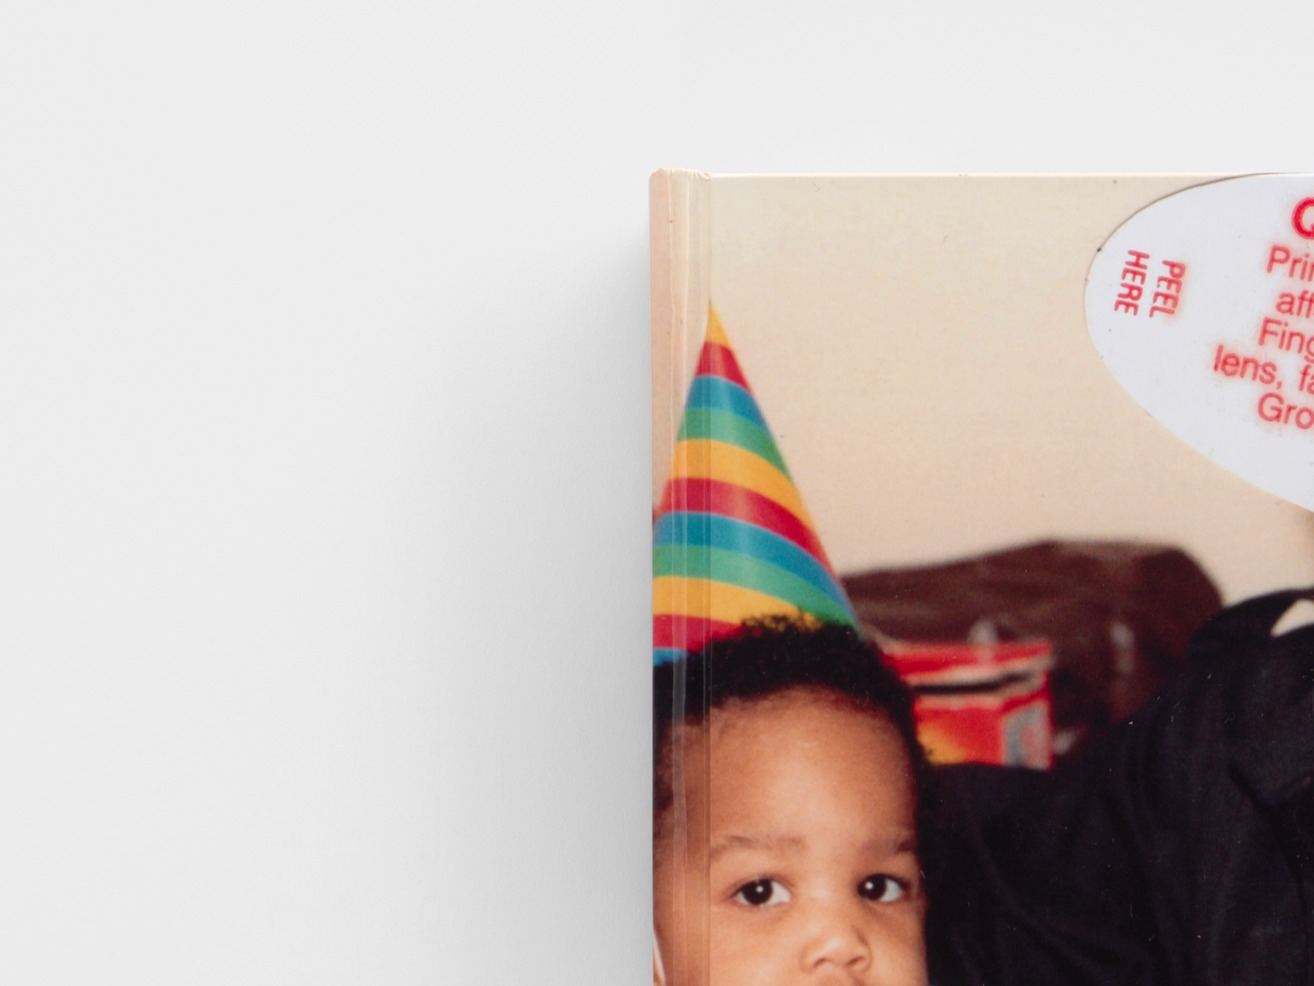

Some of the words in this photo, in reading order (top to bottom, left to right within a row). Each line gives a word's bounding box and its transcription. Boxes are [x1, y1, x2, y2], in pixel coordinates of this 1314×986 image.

[1113, 249, 1151, 316] HERE
[1148, 259, 1187, 318] PEEL
[1213, 344, 1284, 392] lens,
